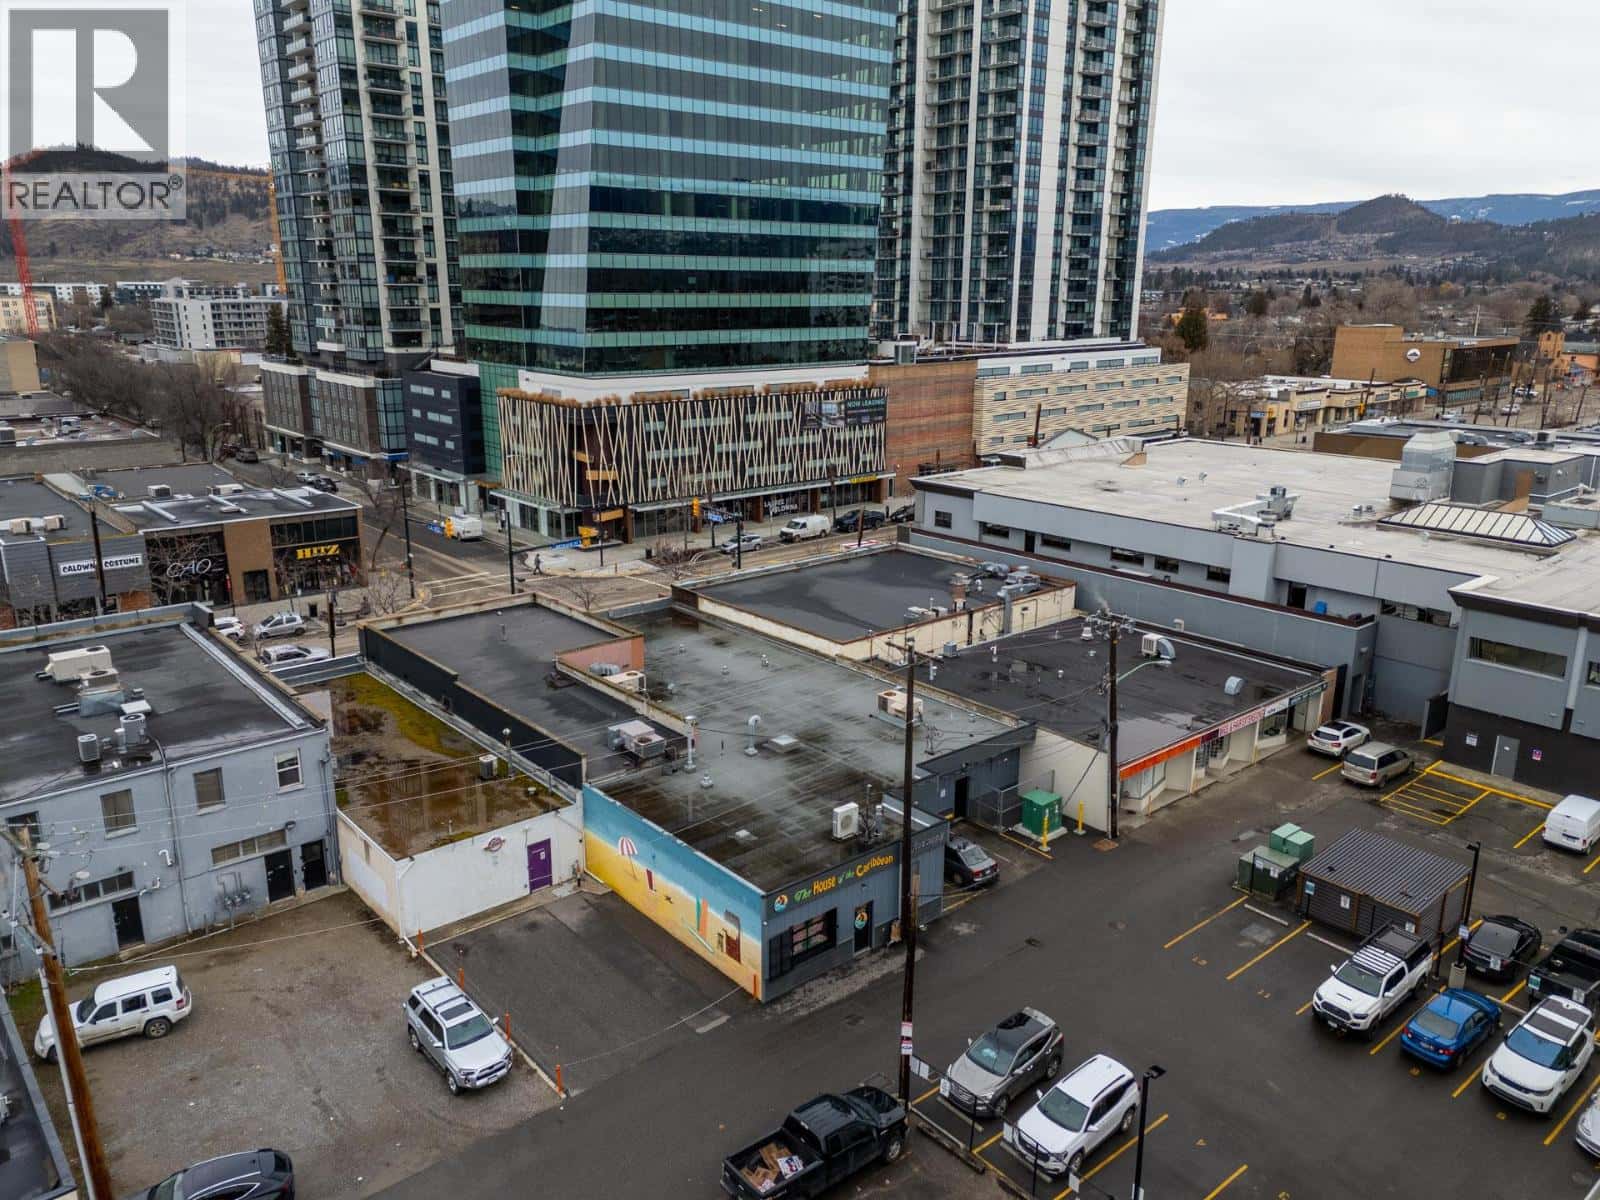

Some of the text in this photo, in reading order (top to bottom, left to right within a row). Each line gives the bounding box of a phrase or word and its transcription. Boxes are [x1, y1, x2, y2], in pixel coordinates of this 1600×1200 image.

[847, 398, 885, 408] NOW LEASING
[62, 557, 139, 573] CALOWN COSTUME
[795, 888, 811, 902] The
[813, 876, 837, 895] House
[856, 855, 894, 876] Caribbean
